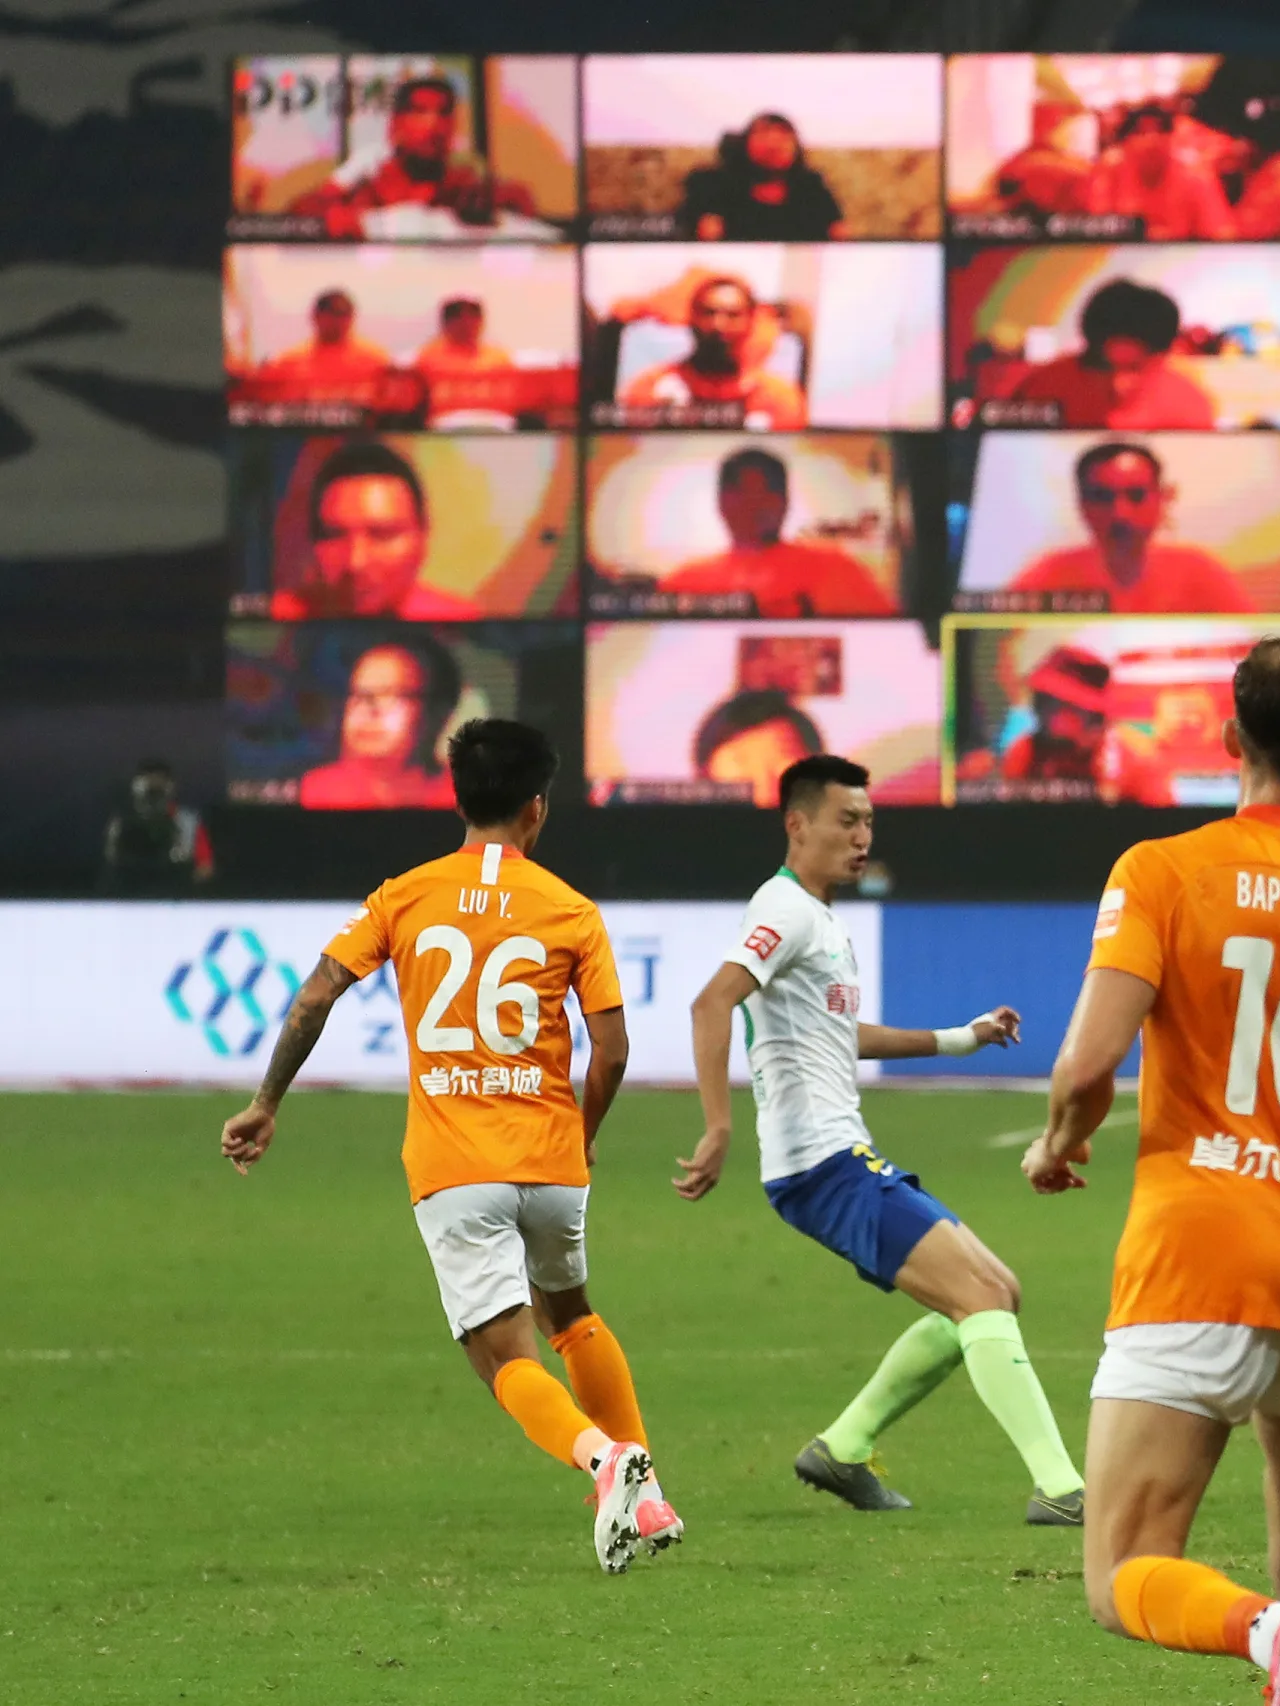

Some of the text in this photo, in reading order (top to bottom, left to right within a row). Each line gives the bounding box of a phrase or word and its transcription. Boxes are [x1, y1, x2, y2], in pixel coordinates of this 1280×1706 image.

[458, 888, 512, 919] LIU Y.
[416, 925, 546, 1055] 26
[418, 1067, 541, 1097] 卓尔智城
